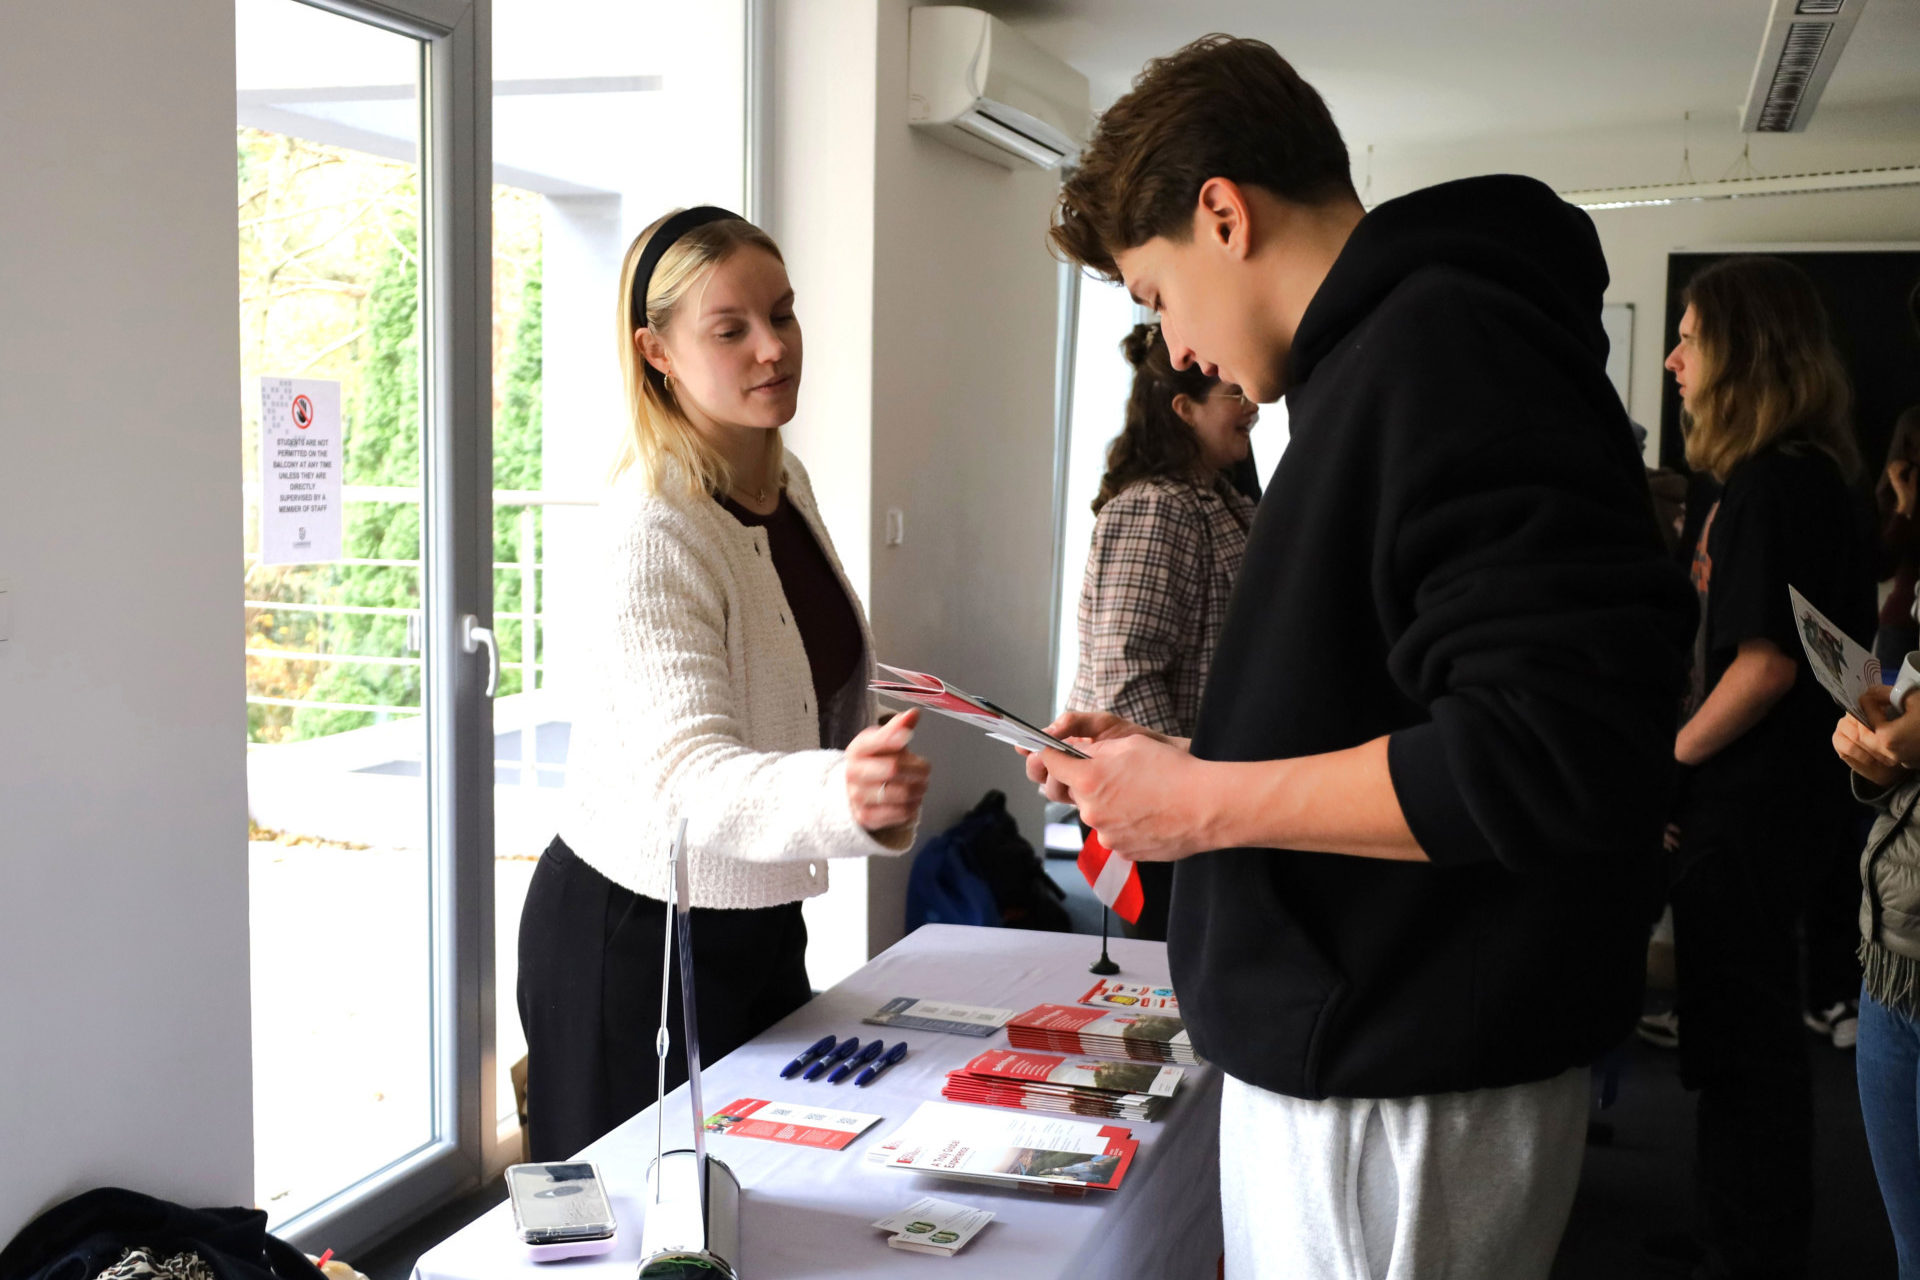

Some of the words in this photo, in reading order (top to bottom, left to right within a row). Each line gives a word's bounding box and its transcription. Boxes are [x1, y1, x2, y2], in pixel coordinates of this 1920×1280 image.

[277, 438, 305, 446] STUDENTS
[278, 505, 302, 513] MEMBER
[310, 504, 328, 512] STAFF
